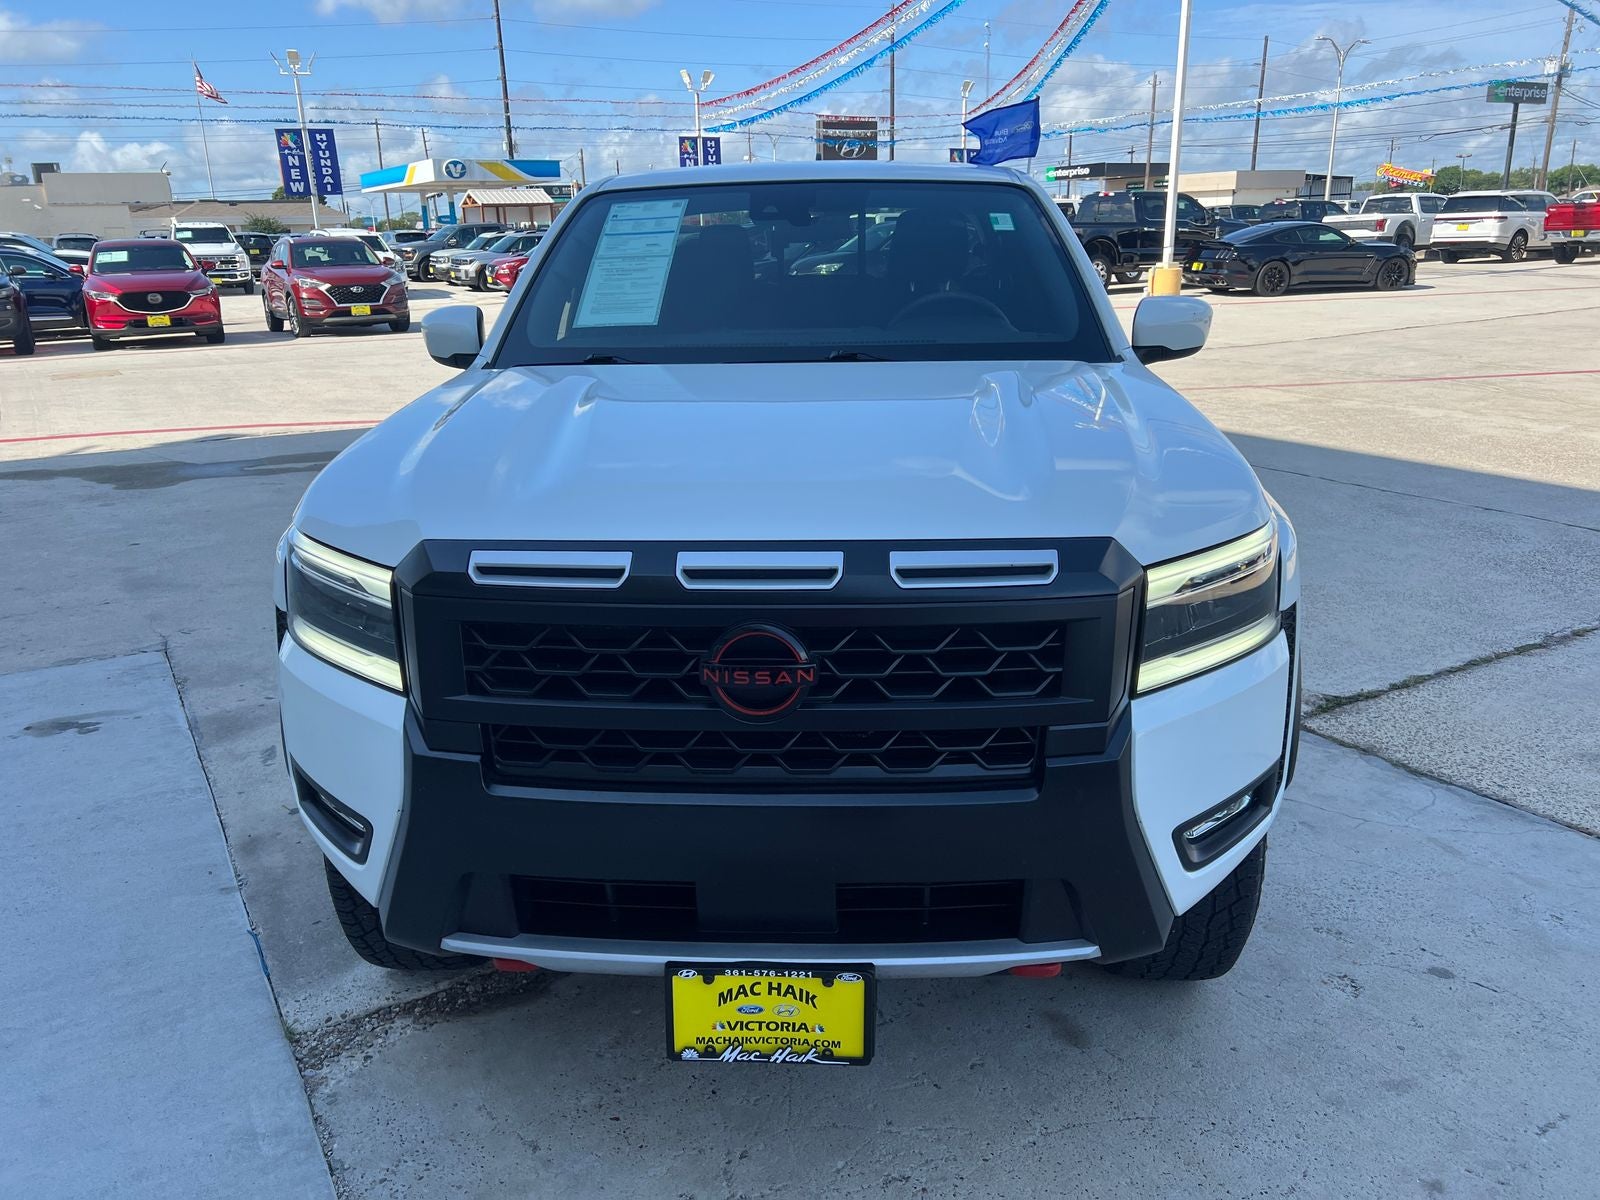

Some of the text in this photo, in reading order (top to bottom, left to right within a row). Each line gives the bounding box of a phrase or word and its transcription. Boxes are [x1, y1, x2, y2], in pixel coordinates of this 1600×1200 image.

[1495, 85, 1547, 100] enterprise
[315, 133, 334, 192] HYUNDAI
[287, 155, 305, 193] NEW
[1046, 166, 1090, 178] enterprise
[703, 668, 815, 685] NISSAN
[724, 969, 814, 979] 361-576-1221
[718, 981, 818, 1010] MAC HAIK
[726, 1020, 811, 1034] VICTORIA
[695, 1036, 842, 1049] MACHAIKVICTORIA.COM
[719, 1045, 822, 1064] Mac Haik
